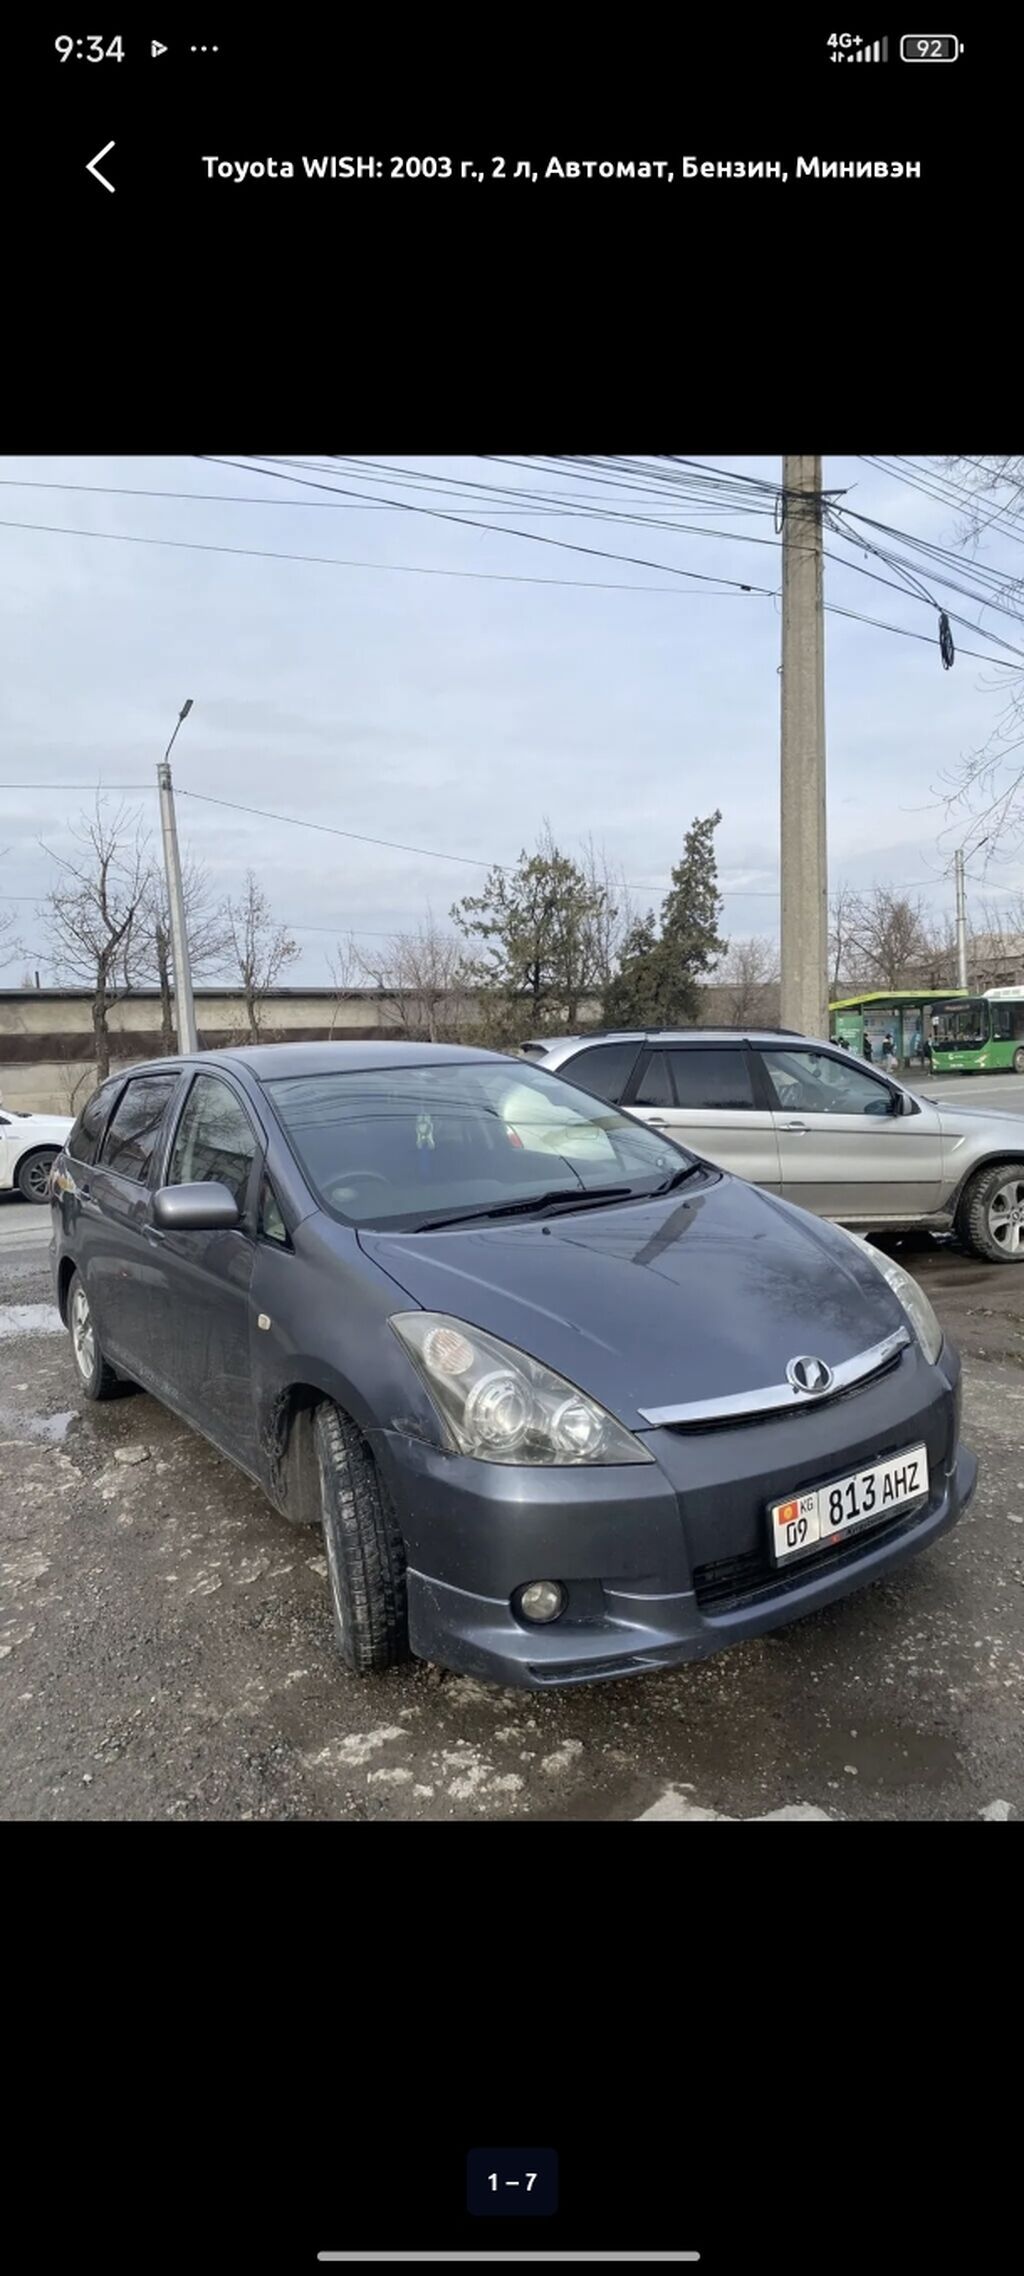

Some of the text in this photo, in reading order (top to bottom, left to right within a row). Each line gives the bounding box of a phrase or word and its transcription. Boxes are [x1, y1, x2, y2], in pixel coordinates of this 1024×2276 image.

[800, 1496, 814, 1515] KG
[829, 1474, 876, 1526] 813
[882, 1461, 920, 1505] AHZ
[786, 1518, 808, 1548] 09
